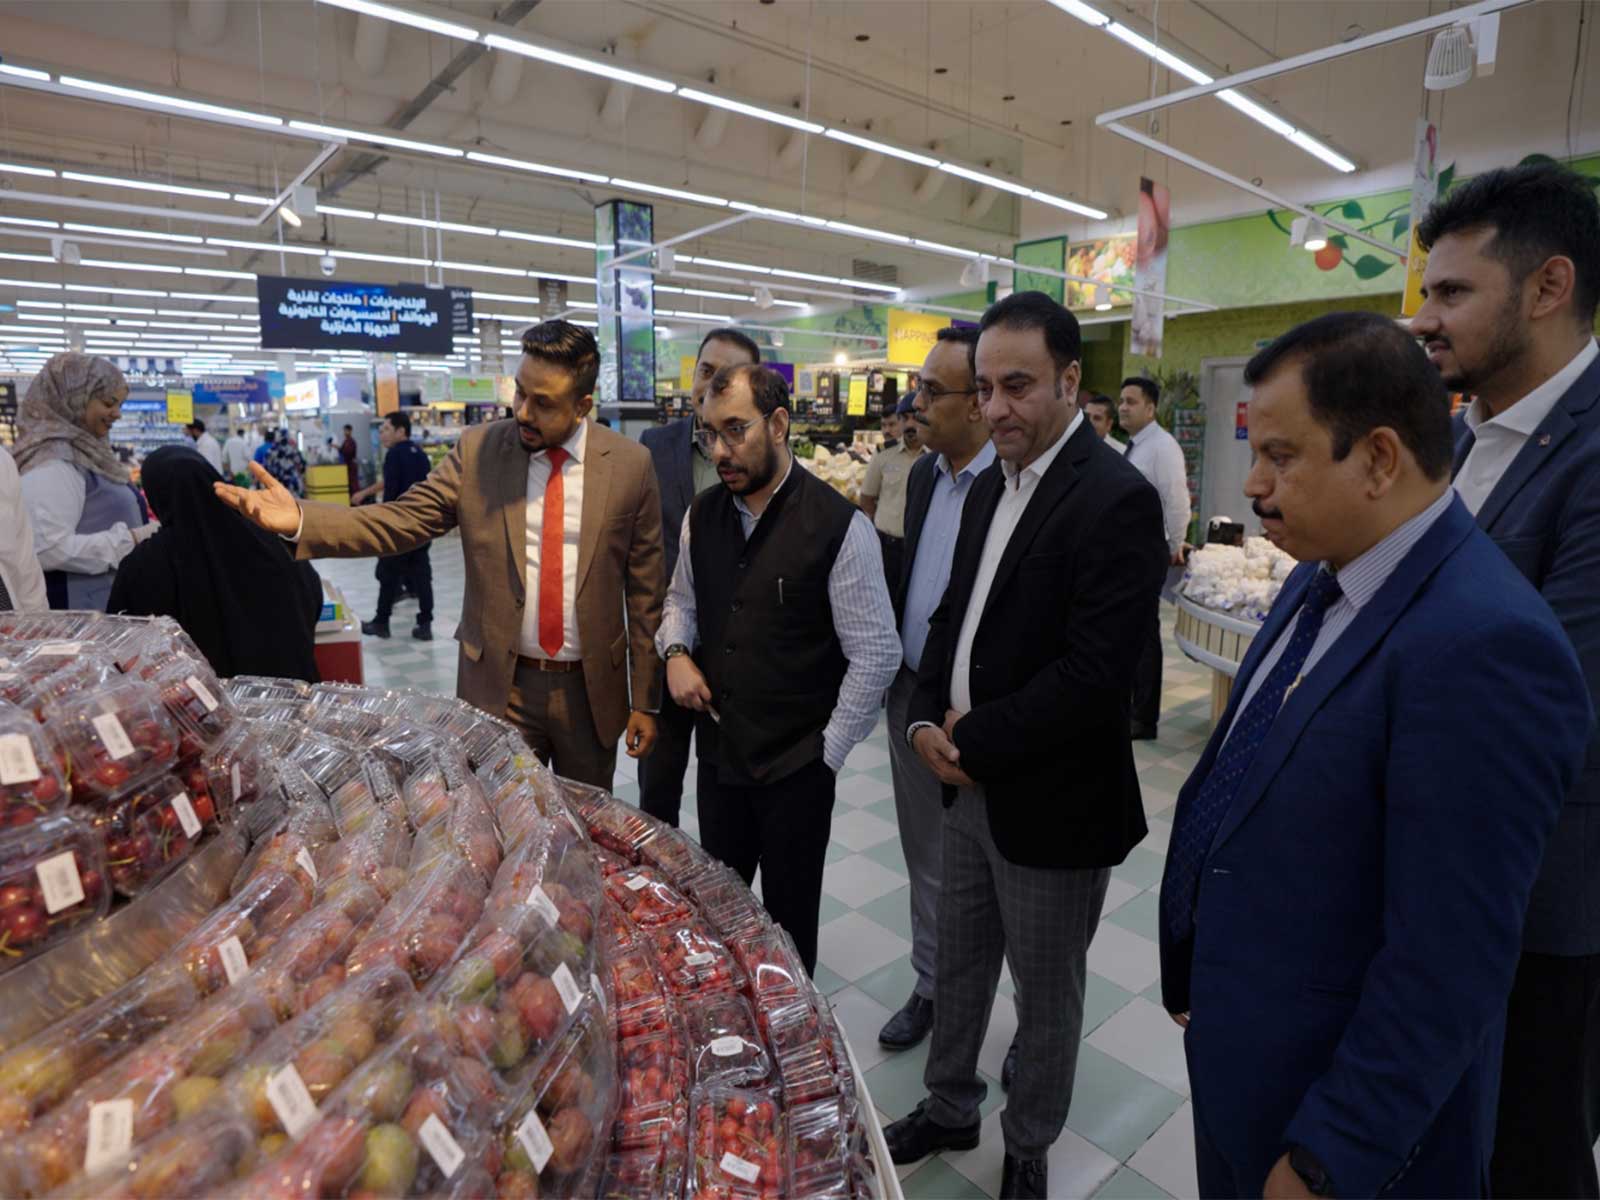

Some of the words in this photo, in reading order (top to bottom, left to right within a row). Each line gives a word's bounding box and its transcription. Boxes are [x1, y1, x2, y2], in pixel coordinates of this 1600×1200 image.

[287, 288, 319, 303] تقنية
[321, 292, 361, 305] منتجات
[398, 312, 438, 326] الهواتف
